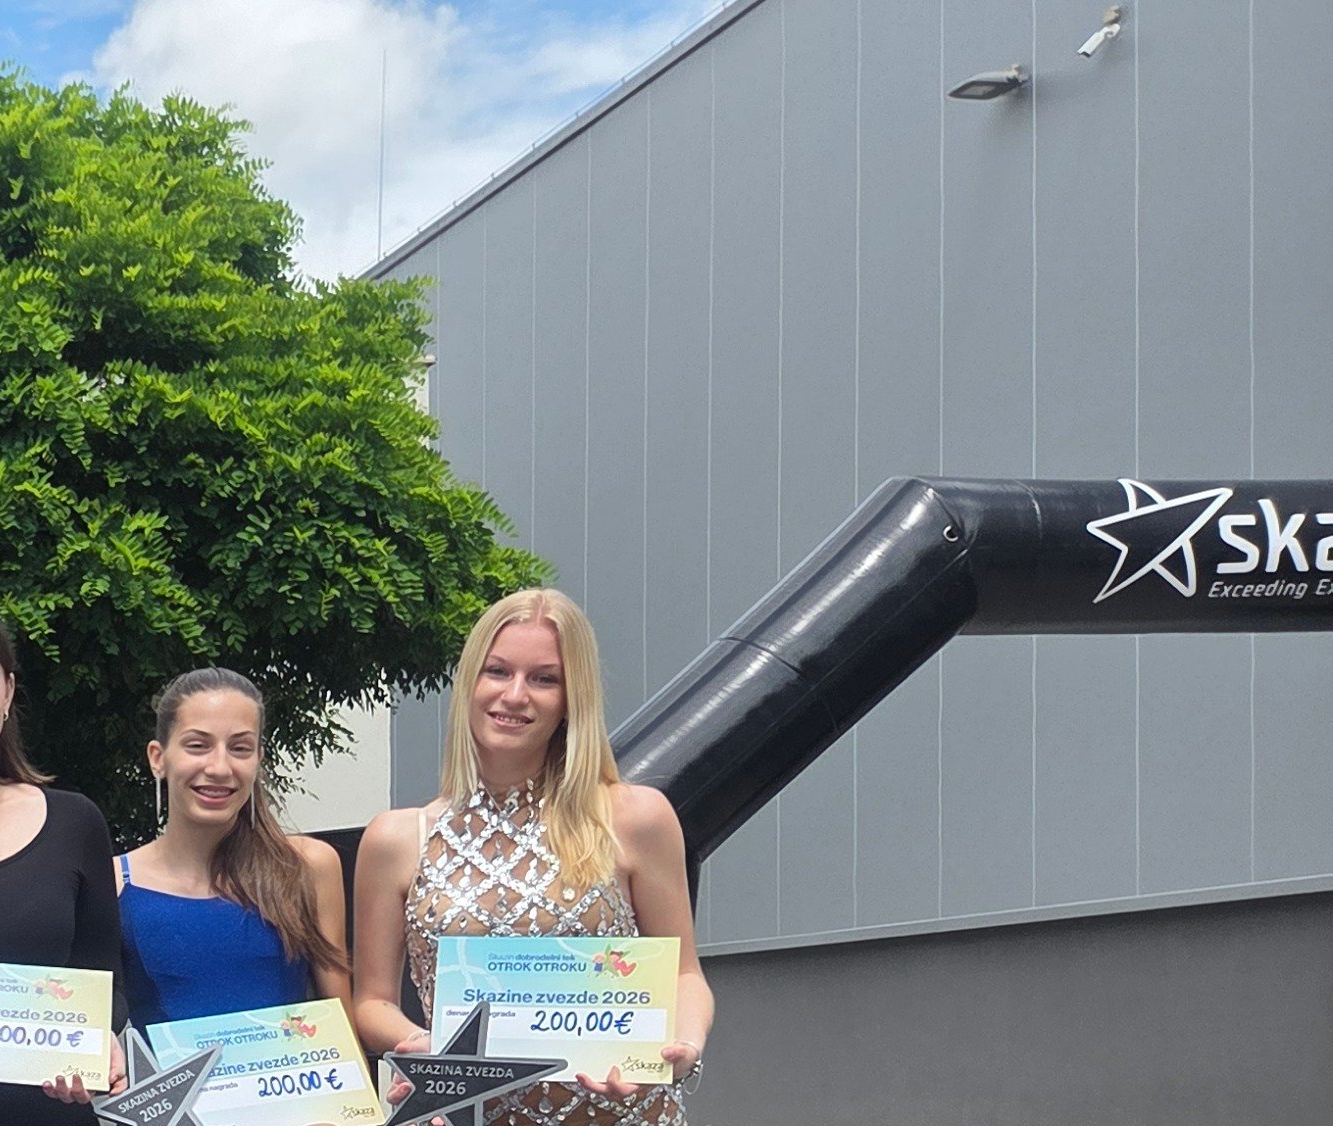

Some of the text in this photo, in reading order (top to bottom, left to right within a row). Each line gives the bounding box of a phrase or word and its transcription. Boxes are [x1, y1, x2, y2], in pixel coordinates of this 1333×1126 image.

[1208, 580, 1308, 600] Exceeding
[488, 962, 587, 972] OTROK OTROKU
[463, 989, 651, 1005] Skazine zvezde 2026
[43, 1010, 88, 1024] 2026
[234, 1031, 278, 1045] OTROKU
[208, 1048, 340, 1078] azine zvezde 2026
[409, 1063, 515, 1079] SKAZINA ZVEZDA
[118, 1069, 195, 1113] SKAZINA ZVEZDA
[424, 1080, 466, 1095] 2026
[139, 1098, 172, 1123] 2026
